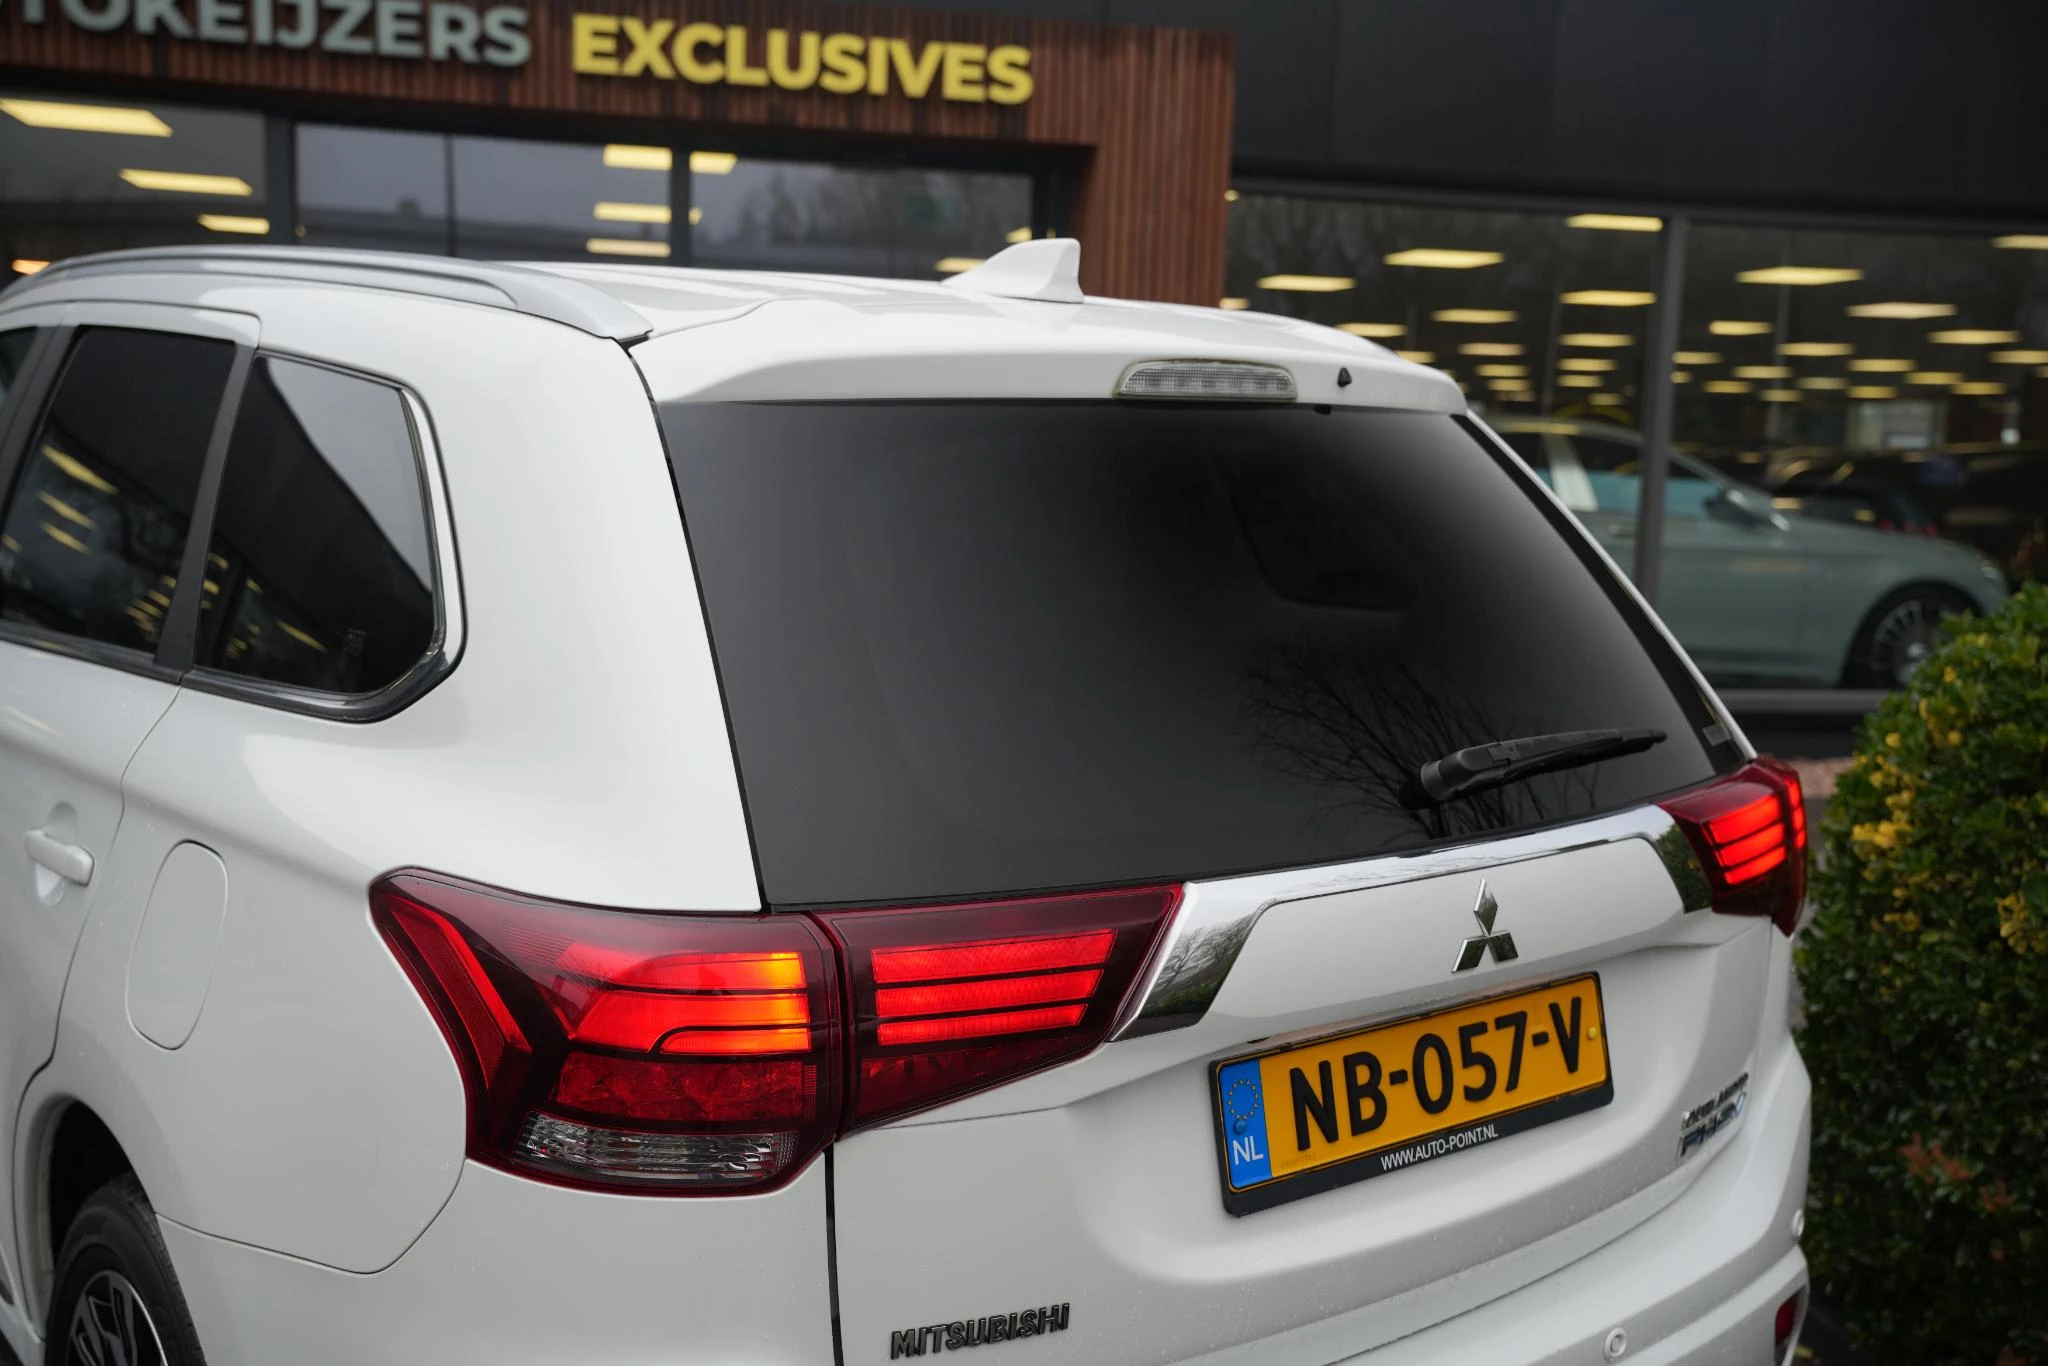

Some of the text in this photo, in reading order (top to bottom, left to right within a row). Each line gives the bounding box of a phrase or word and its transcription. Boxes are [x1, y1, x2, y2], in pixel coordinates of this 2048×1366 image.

[572, 13, 1034, 105] EXCLUSIVES
[1289, 997, 1582, 1151] NB-057-V
[1232, 1135, 1265, 1166] NL
[1380, 1123, 1499, 1171] WWW.AUTO-POINT.NL
[890, 1303, 1070, 1360] MITSUBISHI
